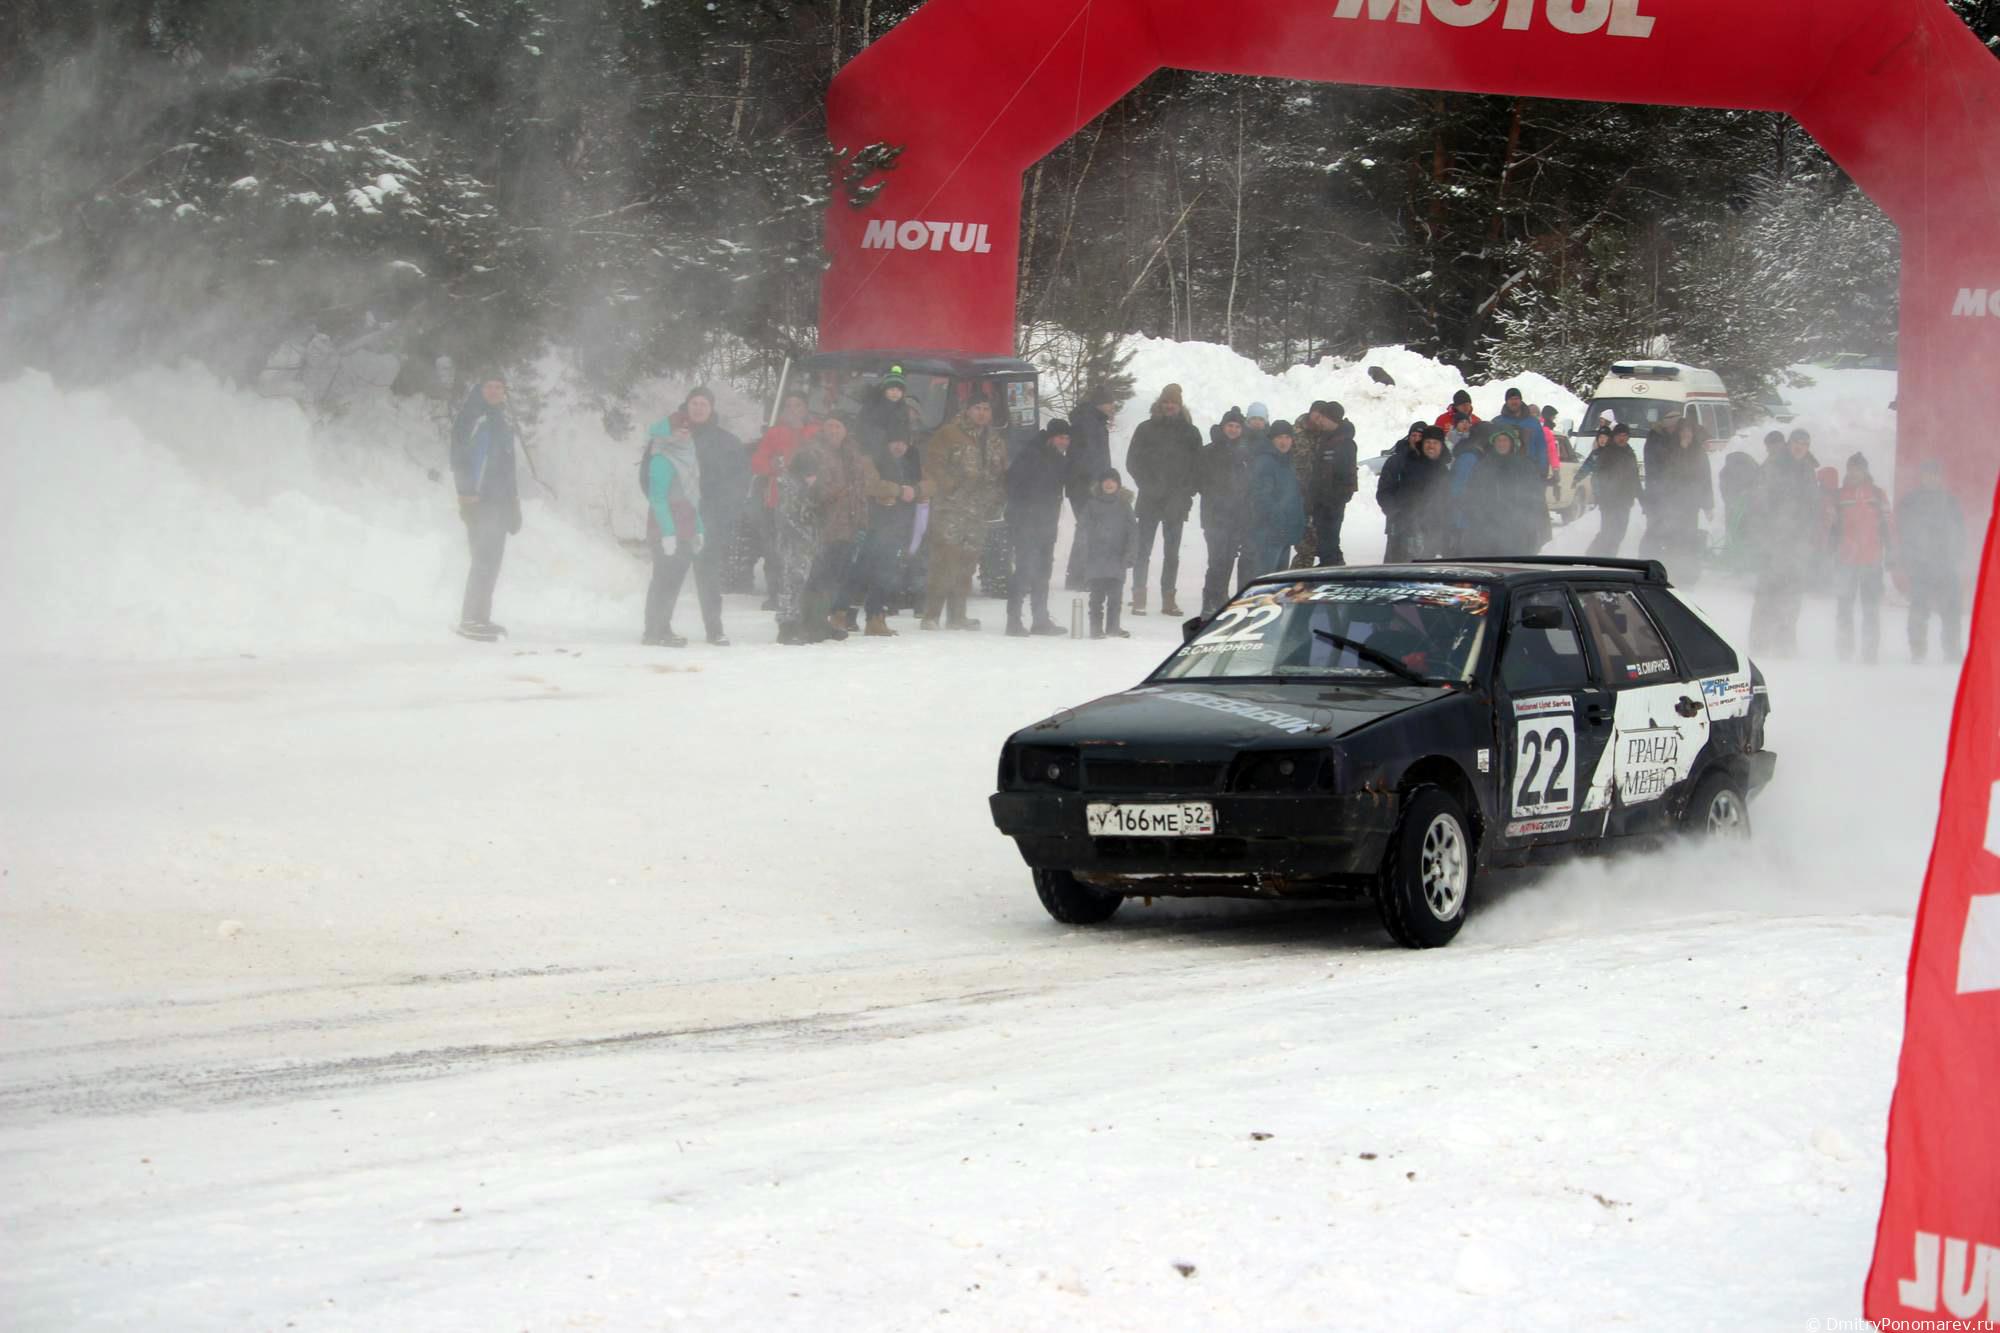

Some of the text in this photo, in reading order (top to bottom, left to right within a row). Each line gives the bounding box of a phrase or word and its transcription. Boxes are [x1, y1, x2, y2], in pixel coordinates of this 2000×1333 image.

[861, 219, 992, 253] MOTUL
[1192, 604, 1282, 646] 22
[1636, 658, 1671, 675] В.СМИРНОВ
[1625, 736, 1678, 765] ГРАНД
[1517, 727, 1569, 807] 22
[1184, 807, 1205, 824] 52
